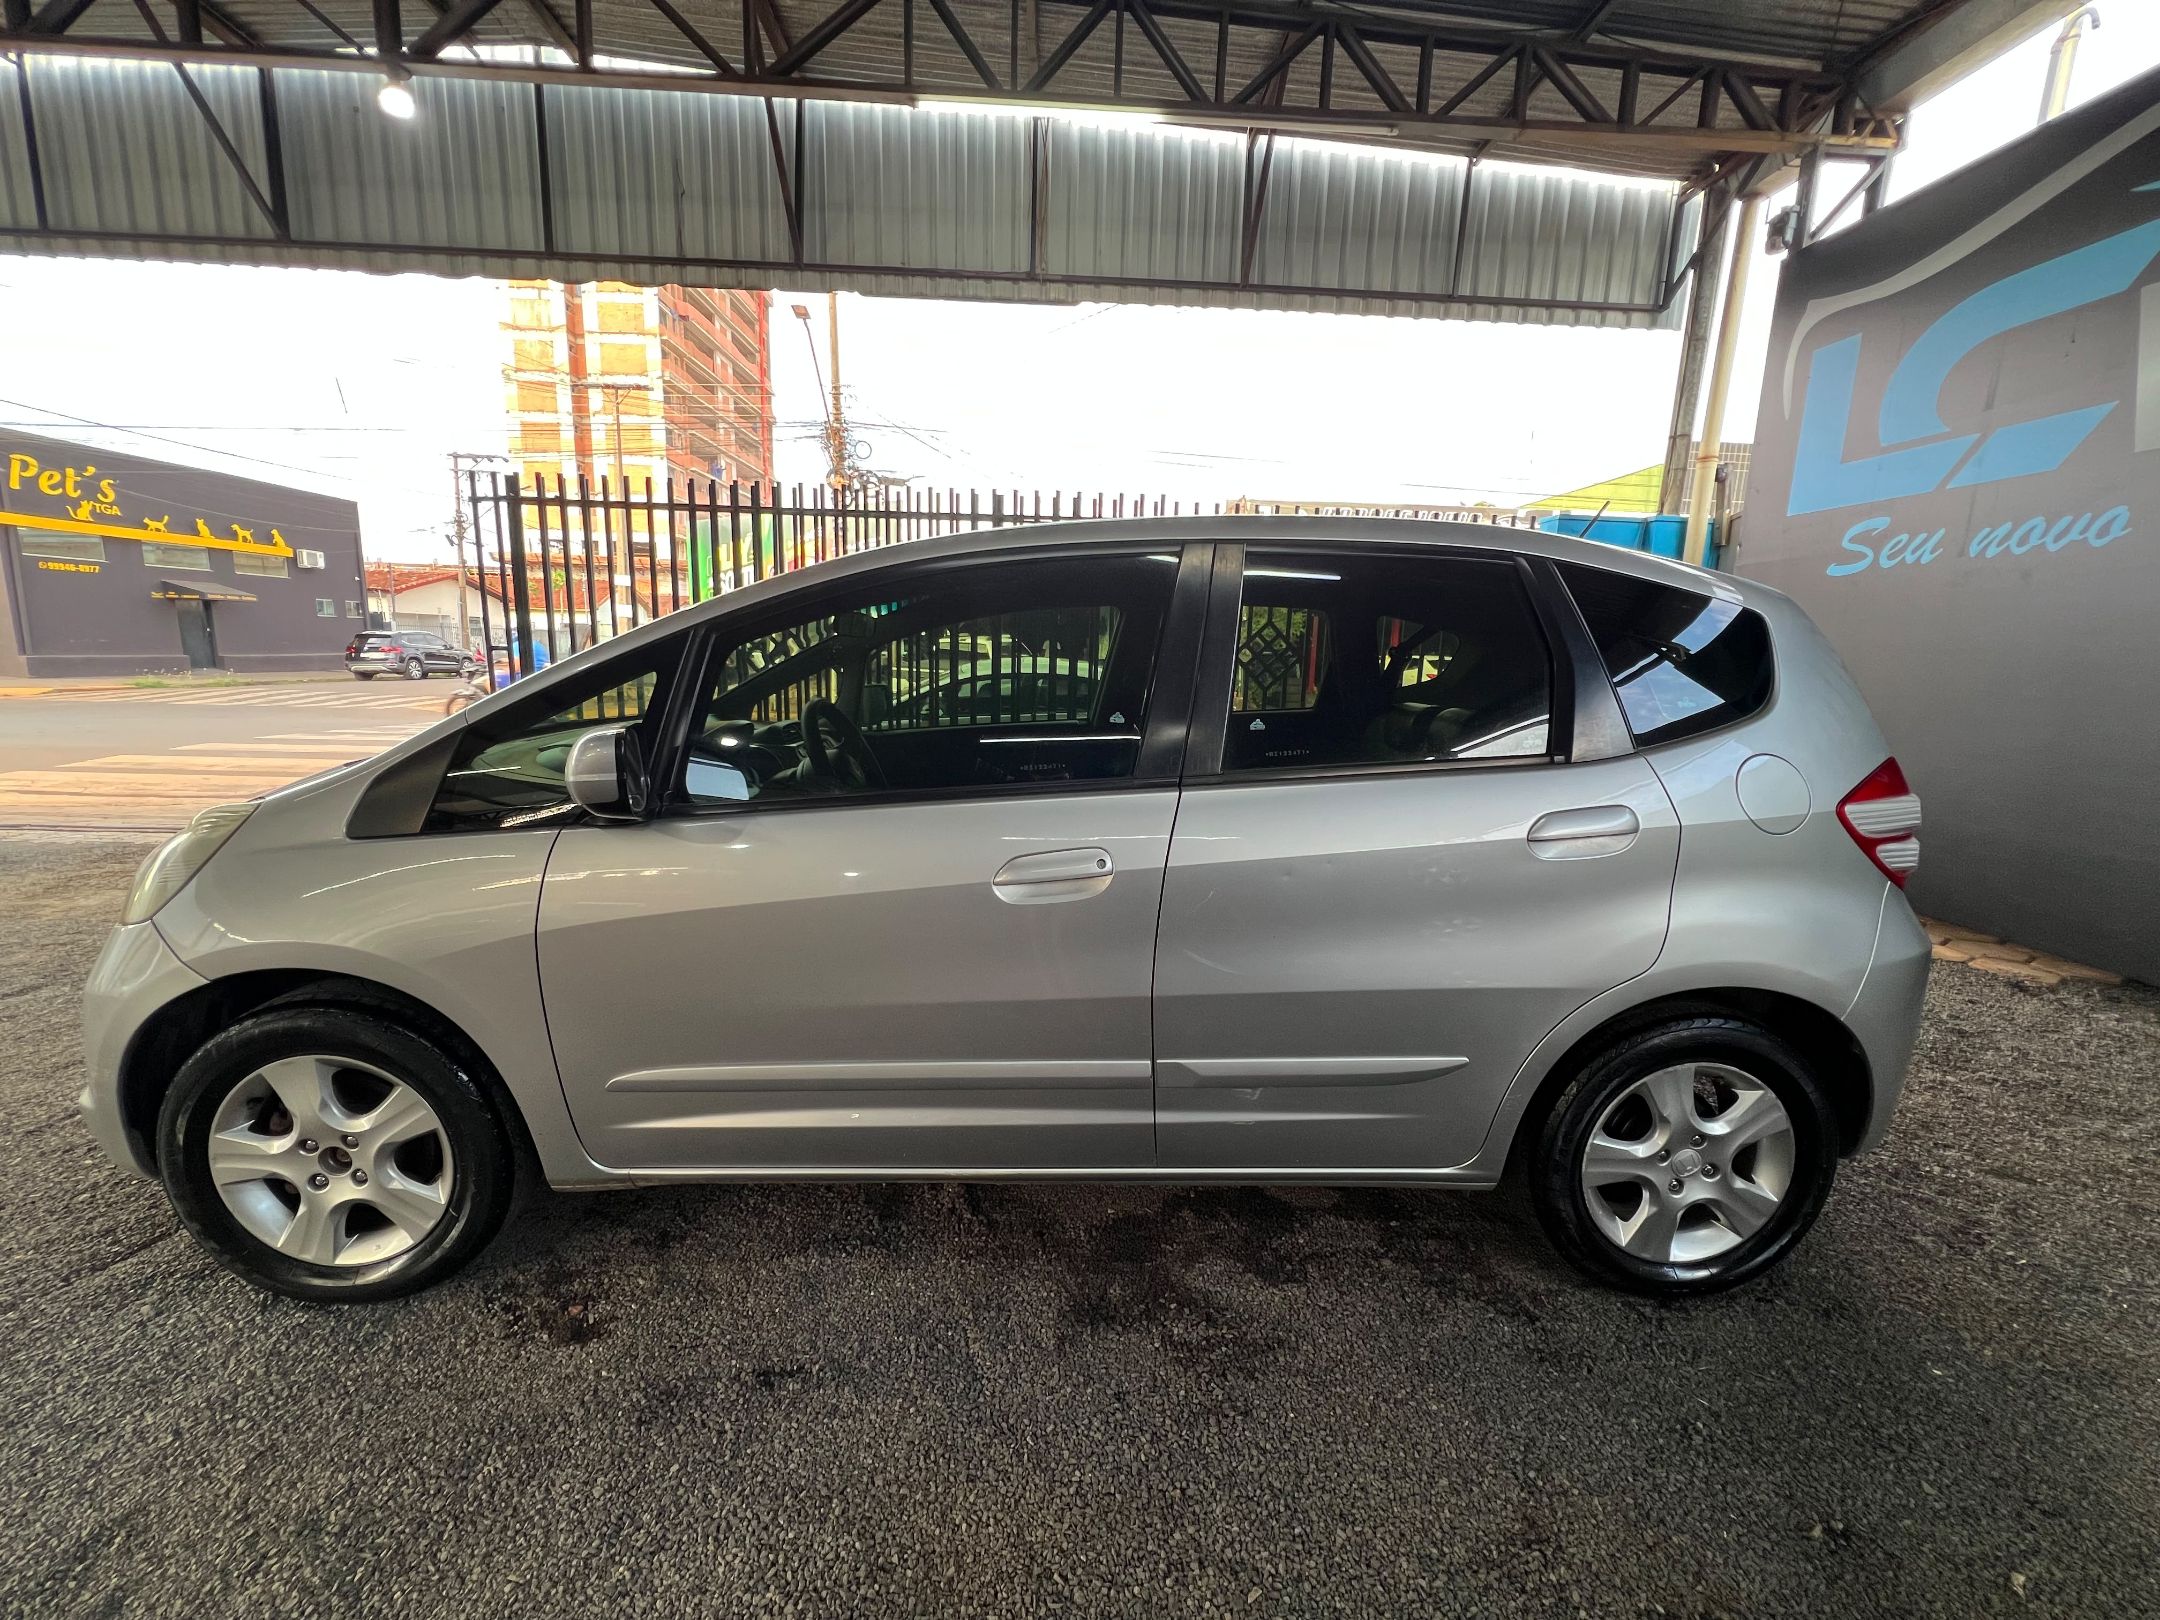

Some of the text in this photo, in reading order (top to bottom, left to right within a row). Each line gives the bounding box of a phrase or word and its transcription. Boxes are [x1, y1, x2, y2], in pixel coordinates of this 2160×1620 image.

[8, 453, 117, 503] Pet's
[93, 503, 121, 516] TGA
[1827, 505, 2132, 577] Seu novo
